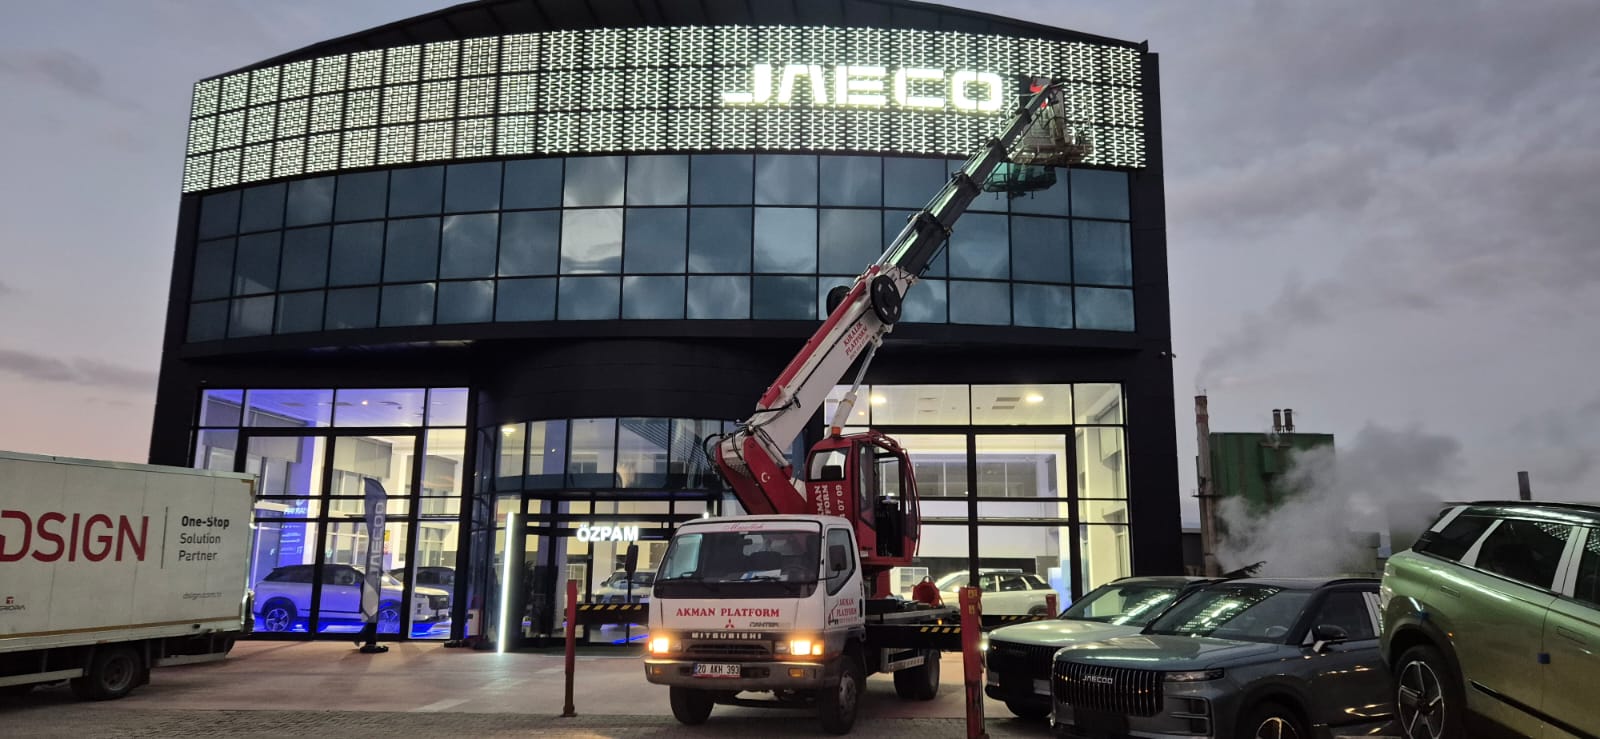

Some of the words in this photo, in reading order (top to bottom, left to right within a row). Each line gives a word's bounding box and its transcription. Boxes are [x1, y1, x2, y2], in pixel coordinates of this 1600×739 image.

[181, 515, 230, 529] One-Stop
[179, 532, 221, 544] Solution
[576, 523, 639, 541] ÖZPAM
[370, 501, 385, 577] JAECOO
[178, 549, 218, 561] Partner
[676, 607, 716, 617] AKMAN
[720, 607, 780, 617] PLATFORM
[691, 632, 762, 640] MITSUBISHI
[698, 665, 706, 674] 20
[726, 665, 740, 675] 393
[1082, 675, 1113, 684] JAECOO
